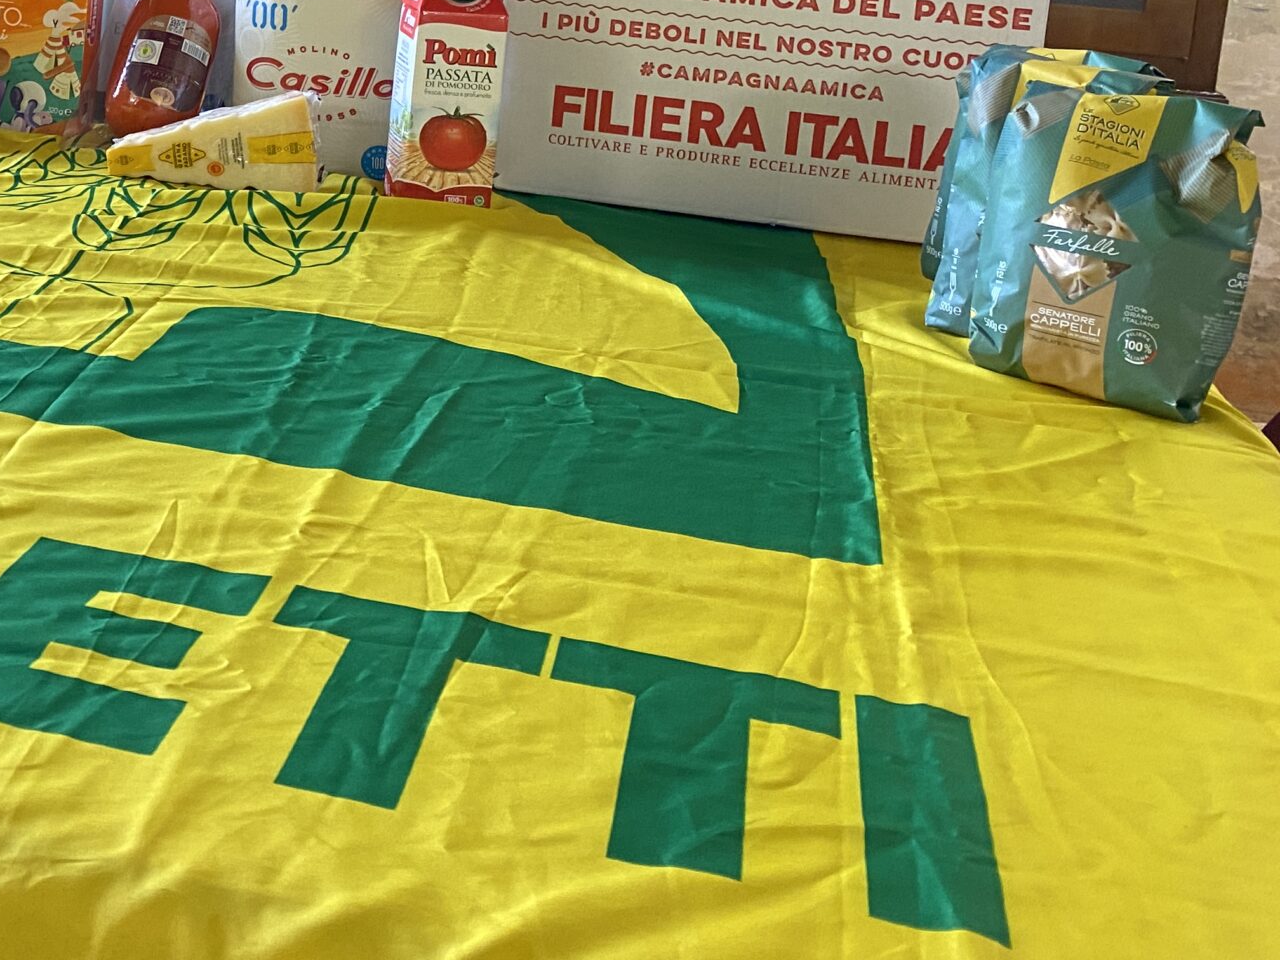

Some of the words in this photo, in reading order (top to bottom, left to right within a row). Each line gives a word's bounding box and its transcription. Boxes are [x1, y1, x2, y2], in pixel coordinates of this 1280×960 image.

[541, 12, 548, 29] I
[558, 8, 600, 34] PIÙ
[609, 19, 707, 46] DEBOLI
[716, 30, 767, 52] NEL
[775, 35, 893, 64] NOSTRO
[287, 45, 351, 60] MOLINO
[422, 38, 498, 69] Pomì
[425, 67, 493, 84] PASSATA
[437, 81, 491, 91] POMODORO
[640, 61, 885, 102] #CAMPAGNAAMICA
[550, 84, 766, 153] FILIERA
[1079, 113, 1146, 139] STAGIONI
[1077, 123, 1140, 151] D'ITALIA
[548, 133, 632, 154] COLTIVARE
[639, 144, 648, 156] E
[656, 146, 741, 168] PRODURRE
[749, 157, 851, 180] ECCELLENZE
[858, 171, 941, 191] ALIMENT
[1042, 229, 1121, 256] Farfalle
[1030, 313, 1101, 337] CAPPELLI
[1038, 306, 1096, 326] SENATORE
[1122, 316, 1160, 330] ITALIANO
[1123, 310, 1154, 322] GRANO
